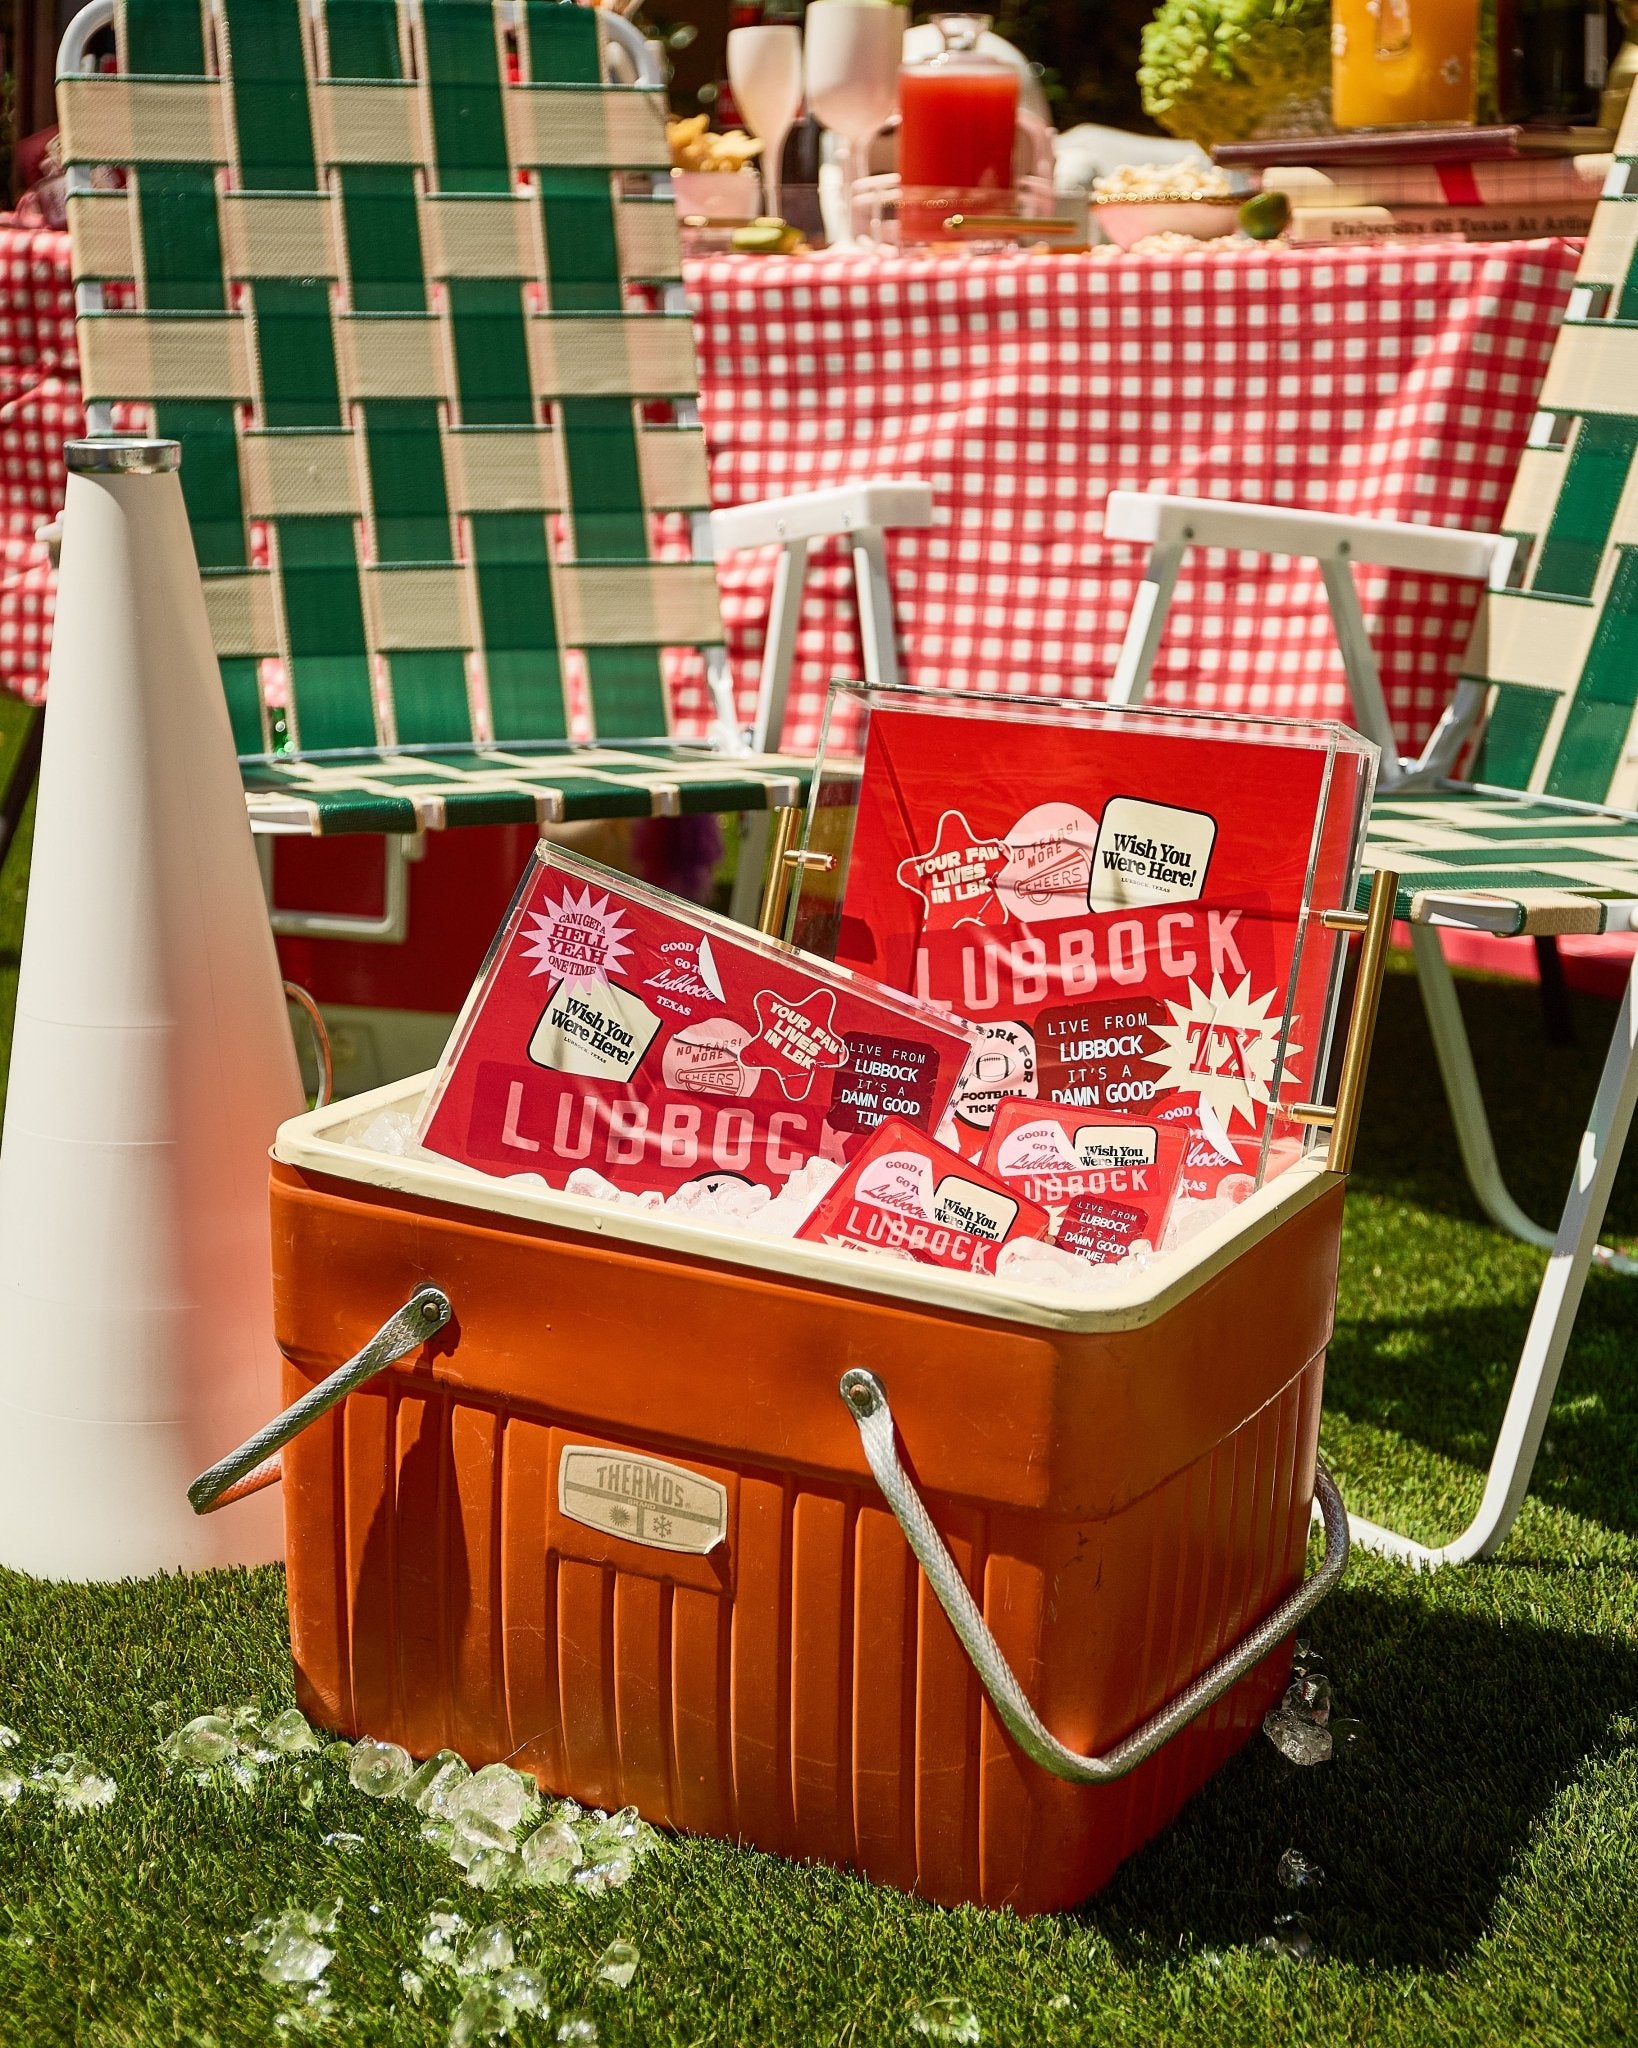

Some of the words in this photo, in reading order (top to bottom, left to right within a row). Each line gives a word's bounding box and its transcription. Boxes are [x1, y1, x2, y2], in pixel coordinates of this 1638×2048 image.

[1032, 820, 1079, 854] TEARS!
[1028, 842, 1062, 869] MORE
[1114, 833, 1157, 860] Wish
[1160, 843, 1192, 867] You
[915, 851, 961, 877] YOUR
[932, 863, 986, 889] LIVES
[1102, 850, 1146, 876] Were
[1147, 861, 1197, 887] Here!
[931, 888, 951, 904] IN
[956, 879, 994, 901] LBK
[1026, 867, 1082, 891] CHEERS
[559, 913, 577, 925] CAN
[576, 913, 583, 925] I
[583, 914, 601, 931] GET
[600, 926, 606, 934] A
[550, 923, 609, 951] HELL
[661, 942, 694, 952] GOOD
[547, 937, 607, 966] YEAH
[675, 957, 690, 969] GO
[916, 908, 1247, 1012] LUBBOCK
[548, 955, 569, 973] ONE
[568, 961, 596, 976] TIME
[643, 968, 716, 1000] Lubbock
[656, 995, 692, 1016] TEXAS
[565, 997, 605, 1032] Wish
[604, 1019, 634, 1047] You
[769, 1001, 811, 1032] YOUR
[810, 1026, 840, 1055] FAV
[1047, 1019, 1089, 1036] LIVE
[1104, 1012, 1148, 1029] FROM
[551, 1008, 590, 1041] Were
[588, 1031, 635, 1065] Here!
[763, 1028, 783, 1049] IN
[780, 1042, 816, 1070] LBK
[773, 1019, 822, 1057] LIVES
[1060, 1035, 1143, 1062] LUBBOCK
[676, 1045, 692, 1056] NO
[691, 1051, 723, 1063] MORE
[849, 1042, 882, 1056] LIVE
[892, 1050, 926, 1064] FROM
[1186, 1021, 1262, 1081] TX
[854, 1059, 919, 1083] LUBBOCK
[1018, 1045, 1033, 1083] FOR
[1068, 1067, 1107, 1084] IT'S
[1121, 1064, 1132, 1078] A
[685, 1073, 734, 1086] CHEERS
[857, 1079, 887, 1093] IT'S
[897, 1087, 905, 1096] A
[841, 1089, 878, 1109] DAMN
[882, 1096, 920, 1115] GOOD
[961, 1089, 1027, 1100] FOOTBALL
[1051, 1085, 1100, 1106] DAMN
[1105, 1080, 1156, 1103] GOOD
[501, 1081, 852, 1175] LUBBOCK
[1017, 1130, 1048, 1142] GOOD
[1005, 1153, 1076, 1171] Lubbock
[1079, 1156, 1113, 1167] Were
[1114, 1156, 1149, 1167] Here!
[1085, 1145, 1118, 1157] Wish
[1119, 1145, 1143, 1157] You
[885, 1161, 917, 1173] GOOD
[896, 1175, 910, 1188] GO
[1005, 1169, 1149, 1202] UBBOCK
[861, 1183, 928, 1219] Lubbock
[1077, 1201, 1104, 1213] LIVE
[1111, 1209, 1138, 1222] FROM
[934, 1207, 964, 1229] Were
[963, 1221, 1000, 1241] Here!
[943, 1197, 975, 1224] Wish
[974, 1213, 998, 1231] You
[1079, 1213, 1130, 1233] LUBBOCK
[845, 1206, 992, 1266] LUBBOCK
[1064, 1232, 1094, 1247] DAMN
[1096, 1240, 1126, 1255] GOOD
[1079, 1226, 1103, 1238] IT'S
[1073, 1246, 1106, 1263] TIME!
[597, 1463, 685, 1508] THERMOS
[627, 1498, 656, 1510] BRAND
